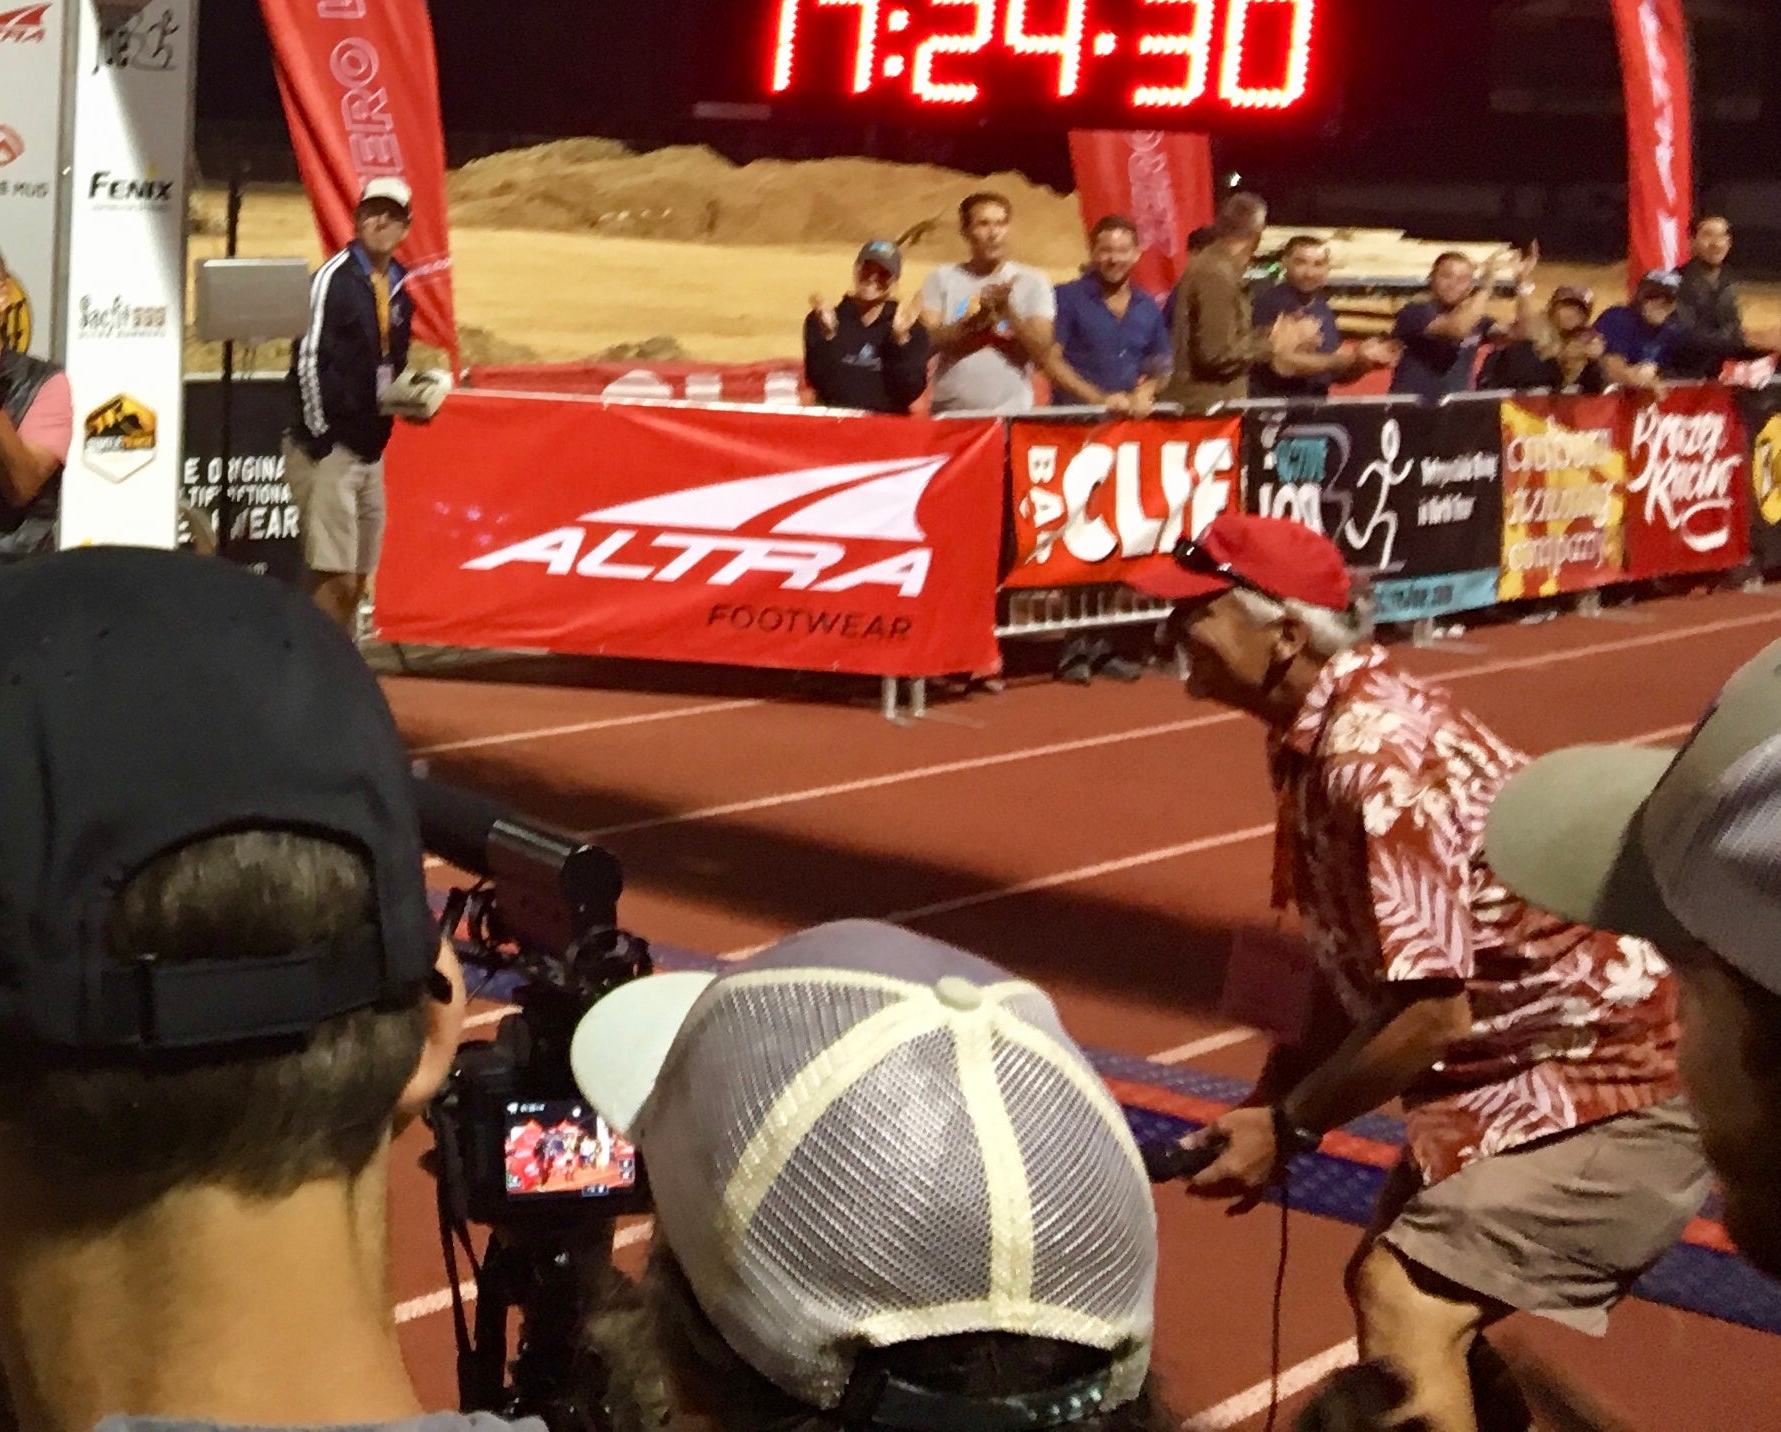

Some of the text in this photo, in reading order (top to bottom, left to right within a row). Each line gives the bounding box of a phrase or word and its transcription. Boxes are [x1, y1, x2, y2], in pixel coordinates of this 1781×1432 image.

[1062, 437, 1234, 562] CLIF
[460, 524, 934, 597] ALTRA
[707, 603, 912, 641] FOOTWEAR
